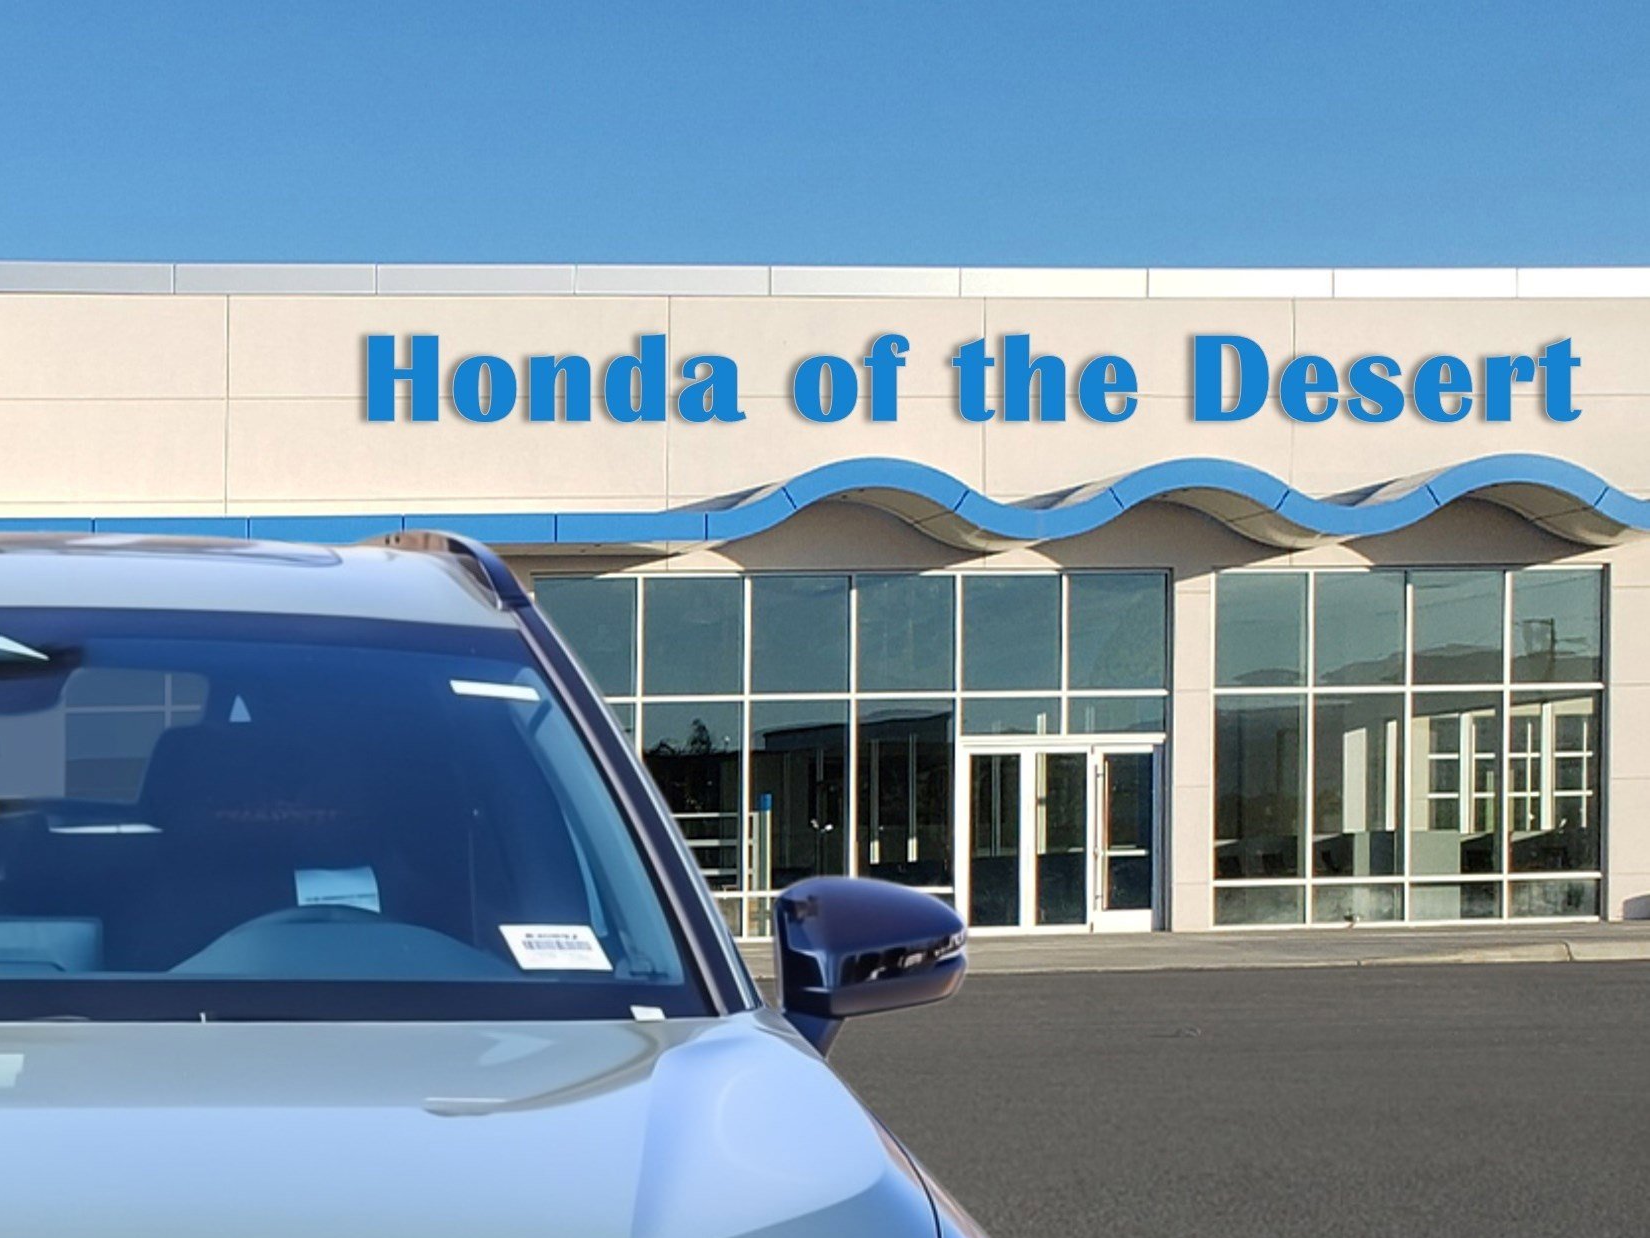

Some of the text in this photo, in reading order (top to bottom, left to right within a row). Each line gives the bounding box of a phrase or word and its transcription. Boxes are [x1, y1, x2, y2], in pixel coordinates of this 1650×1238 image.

[365, 332, 1584, 424] Honda of the Desert
